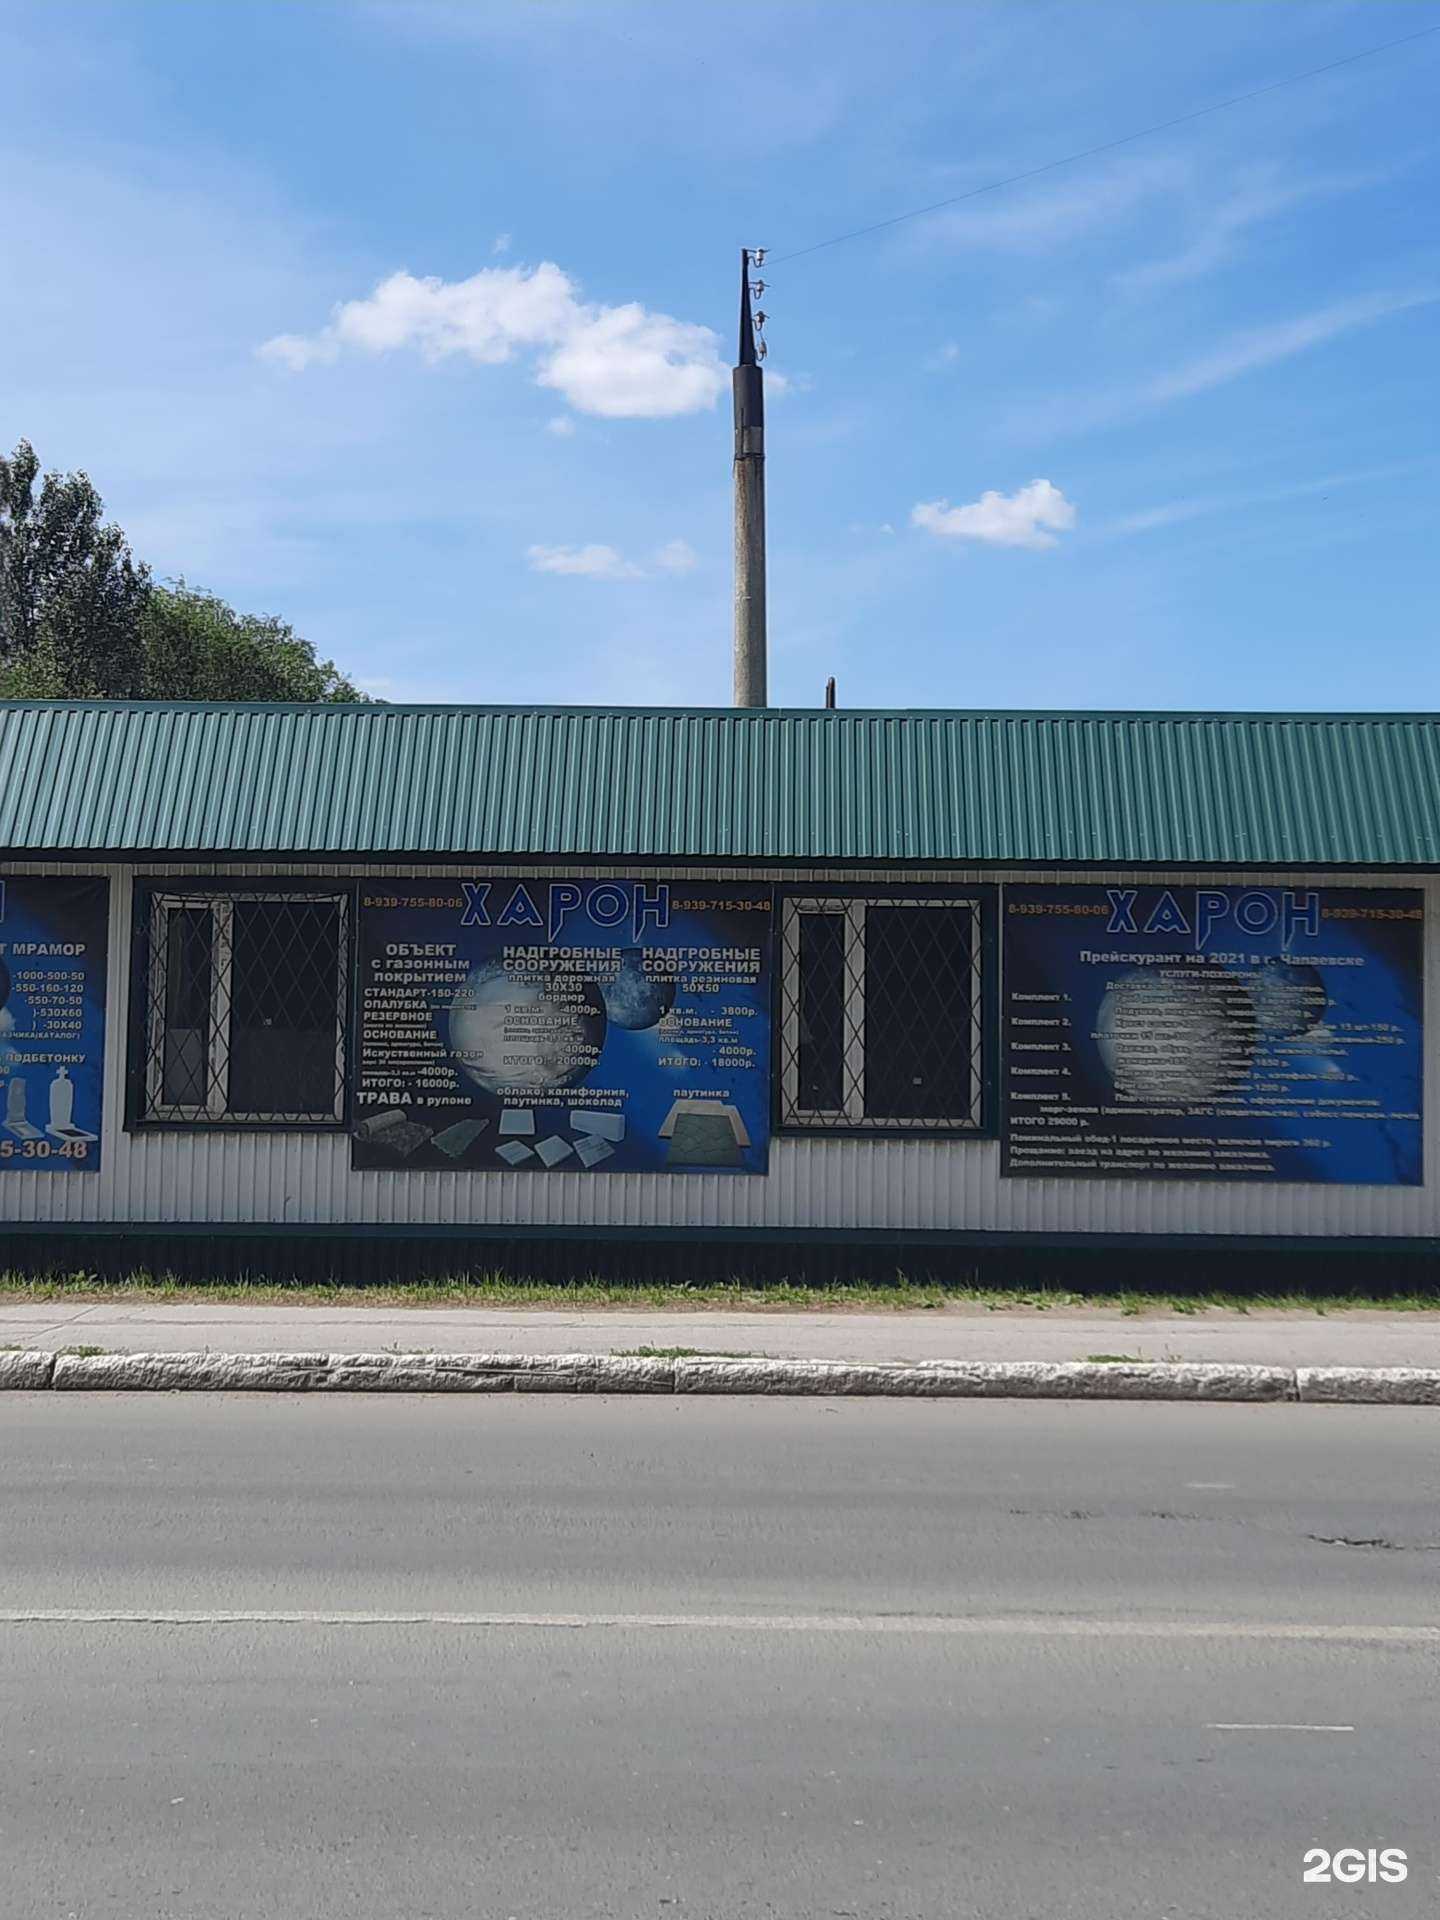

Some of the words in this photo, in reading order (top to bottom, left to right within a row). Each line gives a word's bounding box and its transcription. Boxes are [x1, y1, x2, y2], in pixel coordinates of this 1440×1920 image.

[460, 882, 669, 943] ХАРОН
[671, 900, 771, 911] 8-939-715-30-48
[1106, 889, 1319, 951] ХАРОН
[13, 943, 87, 956] МРАМОР
[386, 944, 457, 957] ОБЪЕКТ
[503, 946, 622, 961] НАДГРОБНЫЕ
[642, 947, 761, 961] НАДГРОБНЫЕ
[1080, 950, 1182, 965] Прейскурант
[1185, 954, 1205, 963] на
[1208, 953, 1245, 964] 2021
[1250, 954, 1260, 964] в
[1280, 952, 1367, 967] Чапаевске
[371, 962, 381, 970] с
[386, 960, 470, 971] газонным
[503, 960, 621, 972] СООРУЖЕНИЯ
[642, 960, 761, 973] СООРУЖЕНИЯ
[373, 971, 467, 984] покрытием
[509, 974, 551, 982] плитка
[554, 974, 616, 984] дорожная
[645, 975, 688, 983] плитка
[538, 992, 586, 1003] бордюр
[363, 1000, 428, 1010] ОПАЛУБКА
[363, 1012, 433, 1022] РЕЗЕРВНОЕ
[503, 1015, 579, 1026] ОСНОВАНИЕ
[659, 1018, 733, 1028] ОСНОВАНИЕ
[363, 1030, 438, 1041] ОСНОВАНИЕ
[6, 1053, 86, 1063] ПОДБЕТОНКУ
[362, 1048, 448, 1060] Искуственный
[496, 1087, 545, 1097] облако,
[548, 1087, 630, 1097] калифорния,
[673, 1089, 730, 1099] паутинка
[356, 1092, 413, 1105] ТРАВА
[416, 1097, 424, 1105] в
[503, 1097, 564, 1107] паутинка,
[567, 1098, 624, 1107] шоколад
[1009, 1116, 1046, 1126] ИТОГО
